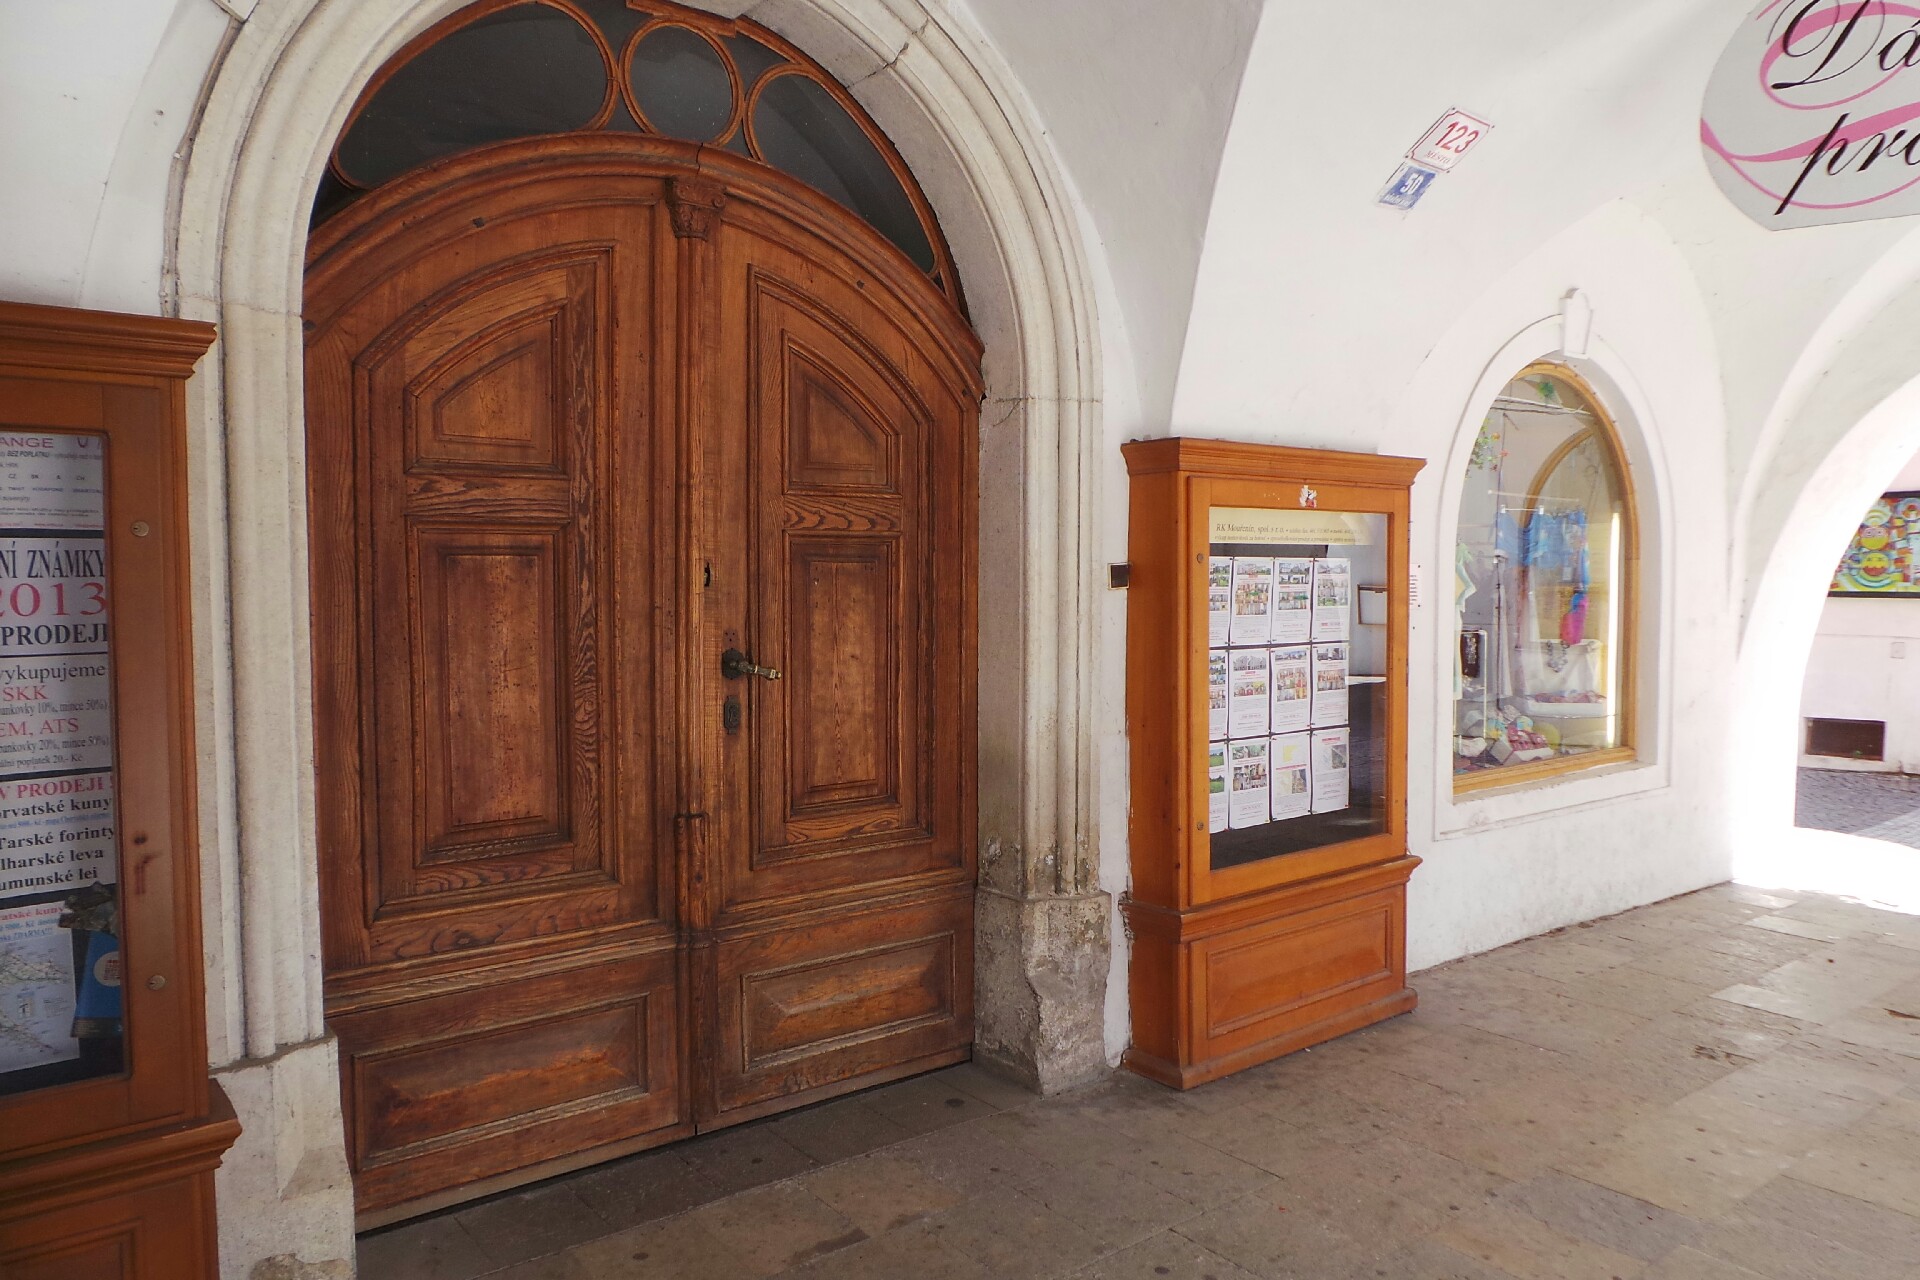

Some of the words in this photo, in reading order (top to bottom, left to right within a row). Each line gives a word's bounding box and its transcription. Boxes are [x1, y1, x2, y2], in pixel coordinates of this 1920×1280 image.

[1435, 120, 1480, 154] 123
[27, 540, 105, 578] ZNÁMKY
[0, 582, 108, 617] 013
[0, 662, 106, 685] ykupujeme
[3, 684, 48, 702] SKK
[60, 702, 84, 712] mince
[40, 717, 79, 735] ATS
[62, 739, 86, 749] mince
[17, 754, 50, 769] poplatek
[17, 776, 105, 799] PRODEJI
[0, 799, 65, 819] rvatské
[70, 794, 112, 811] kuny
[59, 826, 115, 843] forinty
[69, 847, 104, 862] leva
[79, 864, 98, 881] lei
[35, 905, 64, 916] kuny
